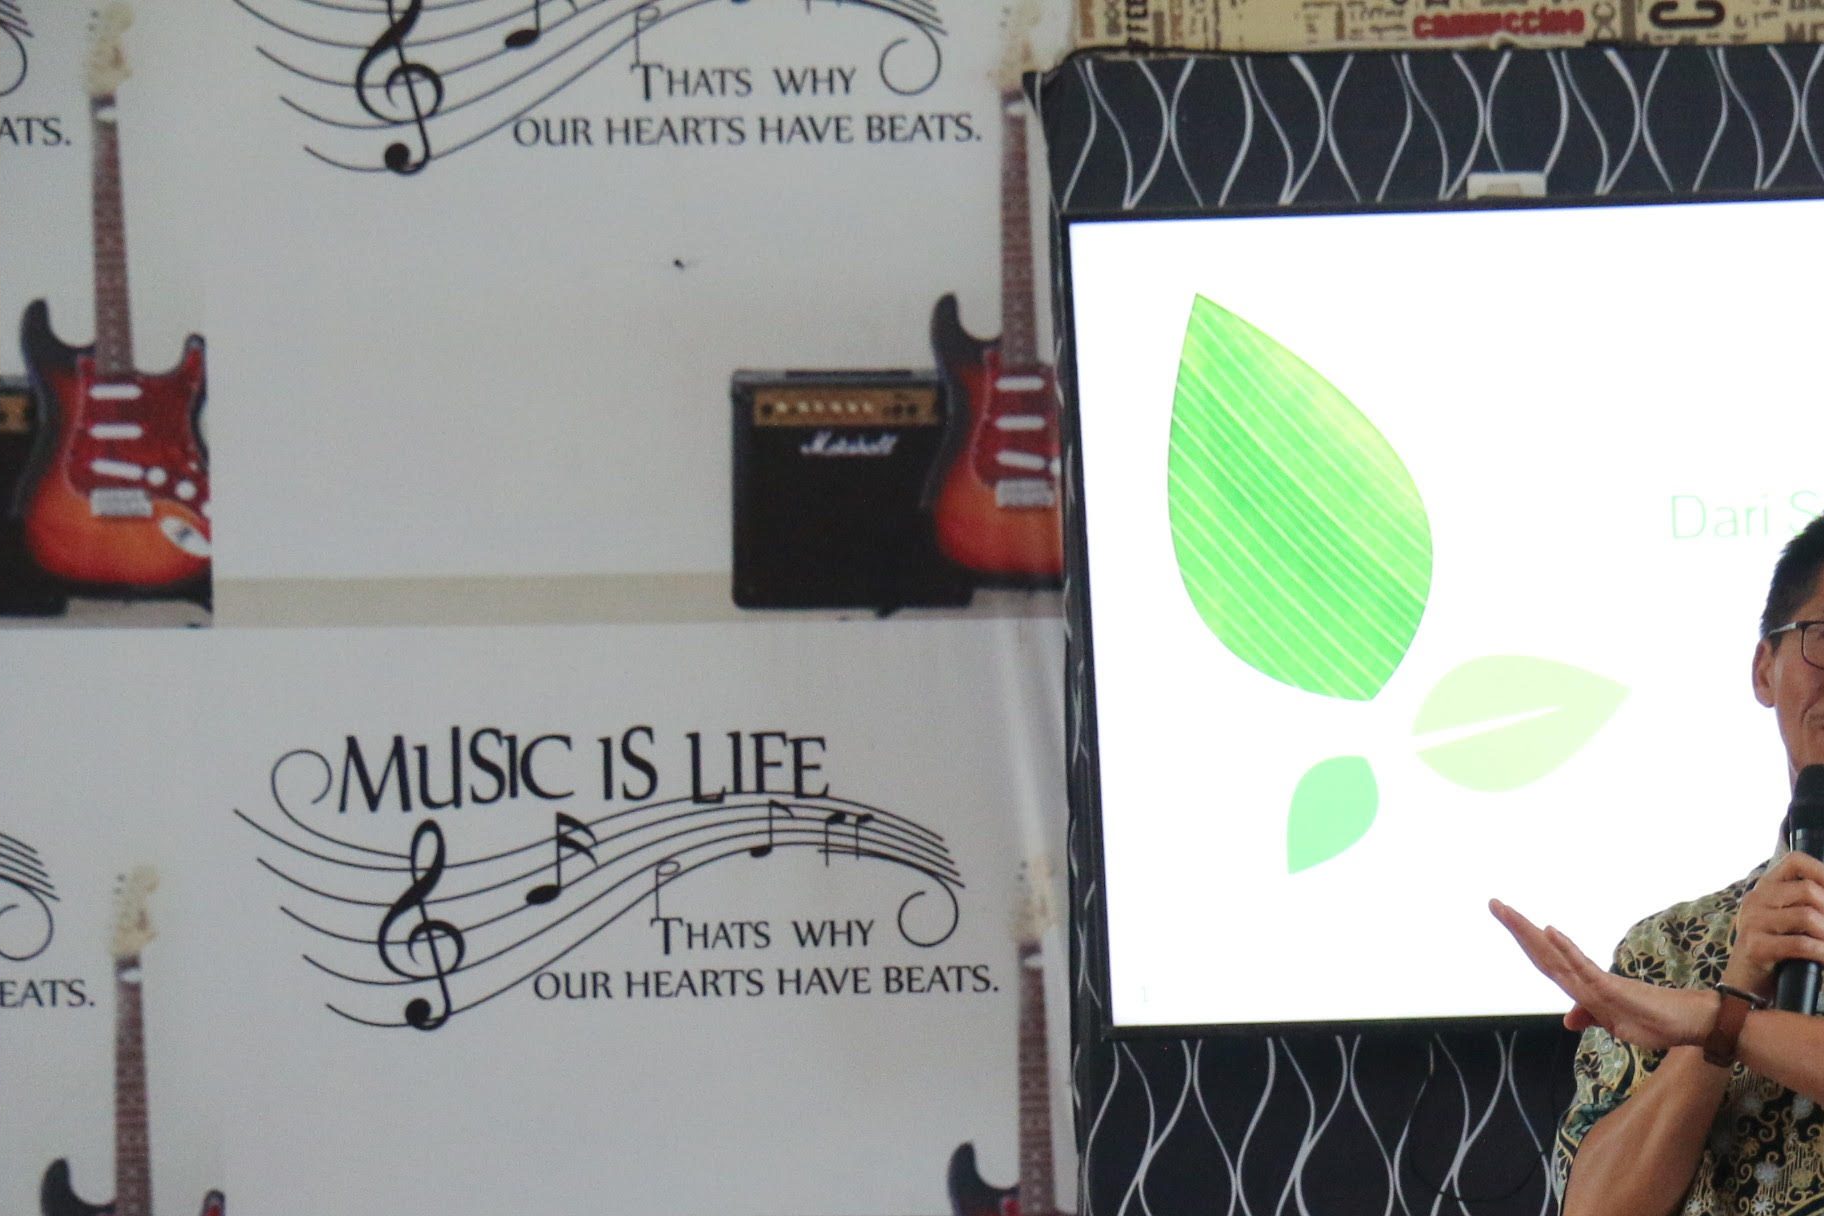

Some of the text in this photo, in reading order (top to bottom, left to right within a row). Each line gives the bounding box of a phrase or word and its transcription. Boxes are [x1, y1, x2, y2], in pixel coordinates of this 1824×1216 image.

[636, 62, 856, 103] THATS WHY
[0, 116, 72, 147] ATS.
[513, 110, 984, 148] OUR HEARTS HAVE BEATS.
[1671, 487, 1770, 541] Dari
[600, 726, 659, 800] IS
[686, 729, 831, 805] LIFE
[651, 917, 876, 955] THATS WHY
[0, 980, 95, 1008] EATS.
[533, 963, 1000, 1001] OUR HEARTS HAVE BEATS.
